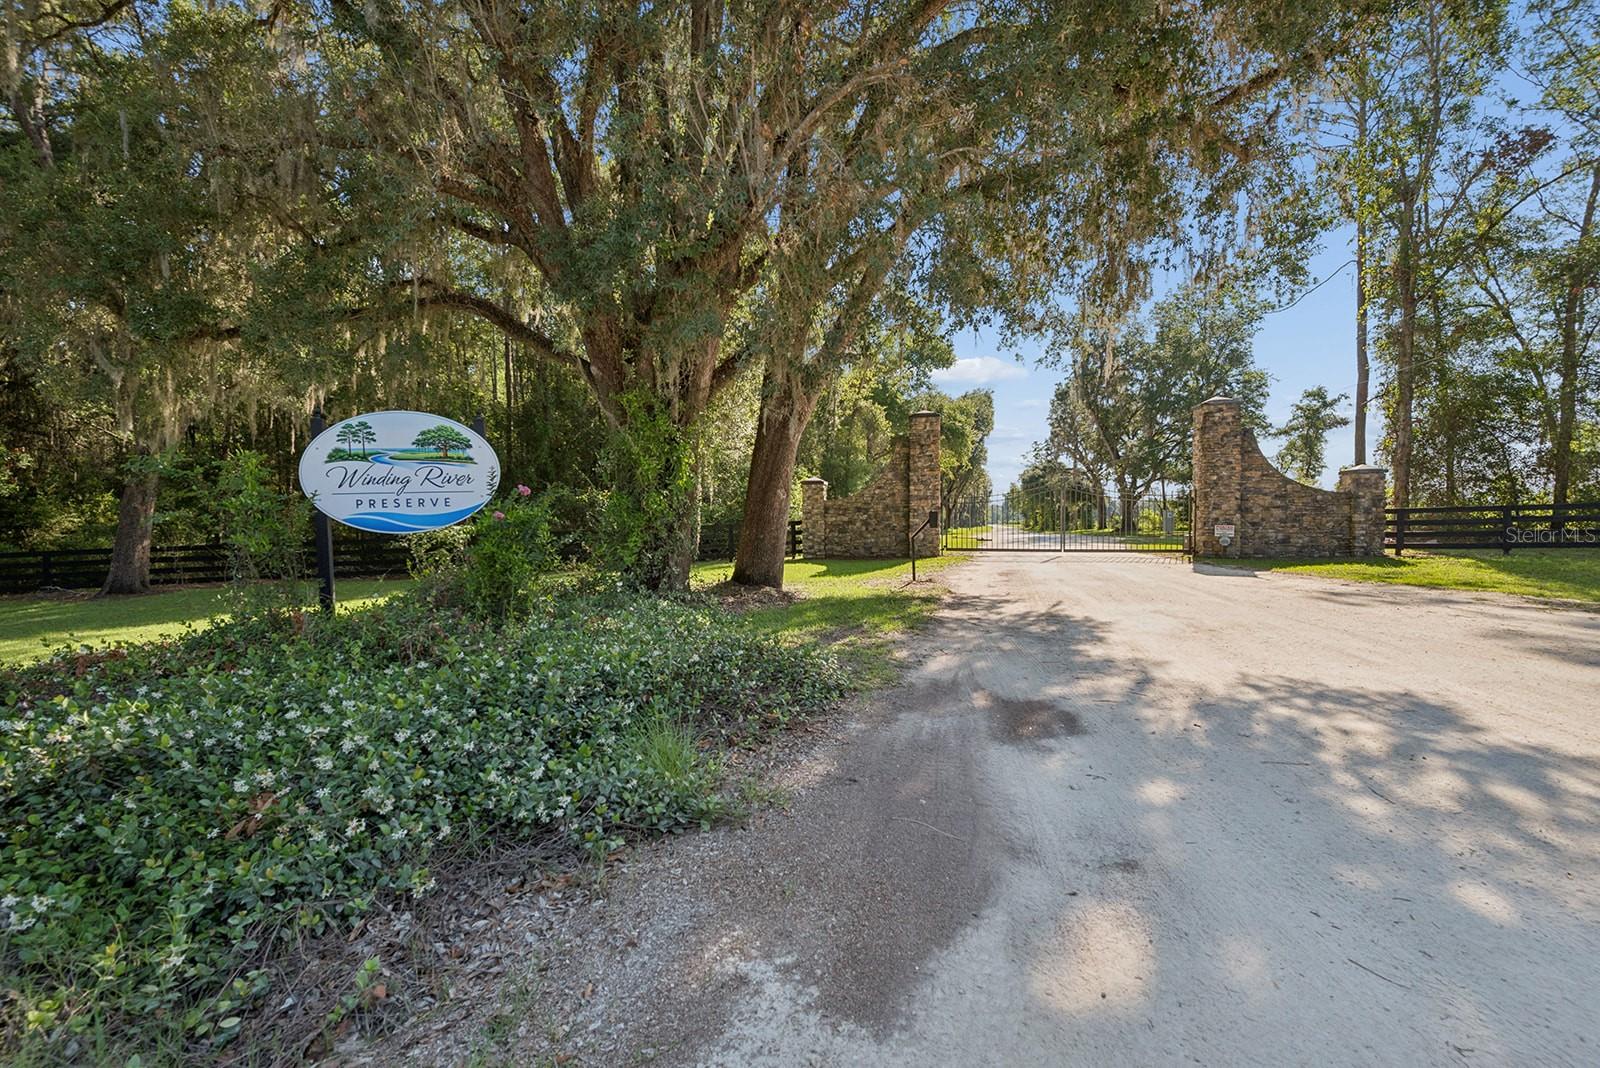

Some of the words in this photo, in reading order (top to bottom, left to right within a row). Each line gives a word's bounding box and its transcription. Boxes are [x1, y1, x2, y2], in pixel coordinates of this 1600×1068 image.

[326, 463, 412, 496] Winding
[415, 465, 475, 488] River
[355, 497, 451, 509] PRESERVE
